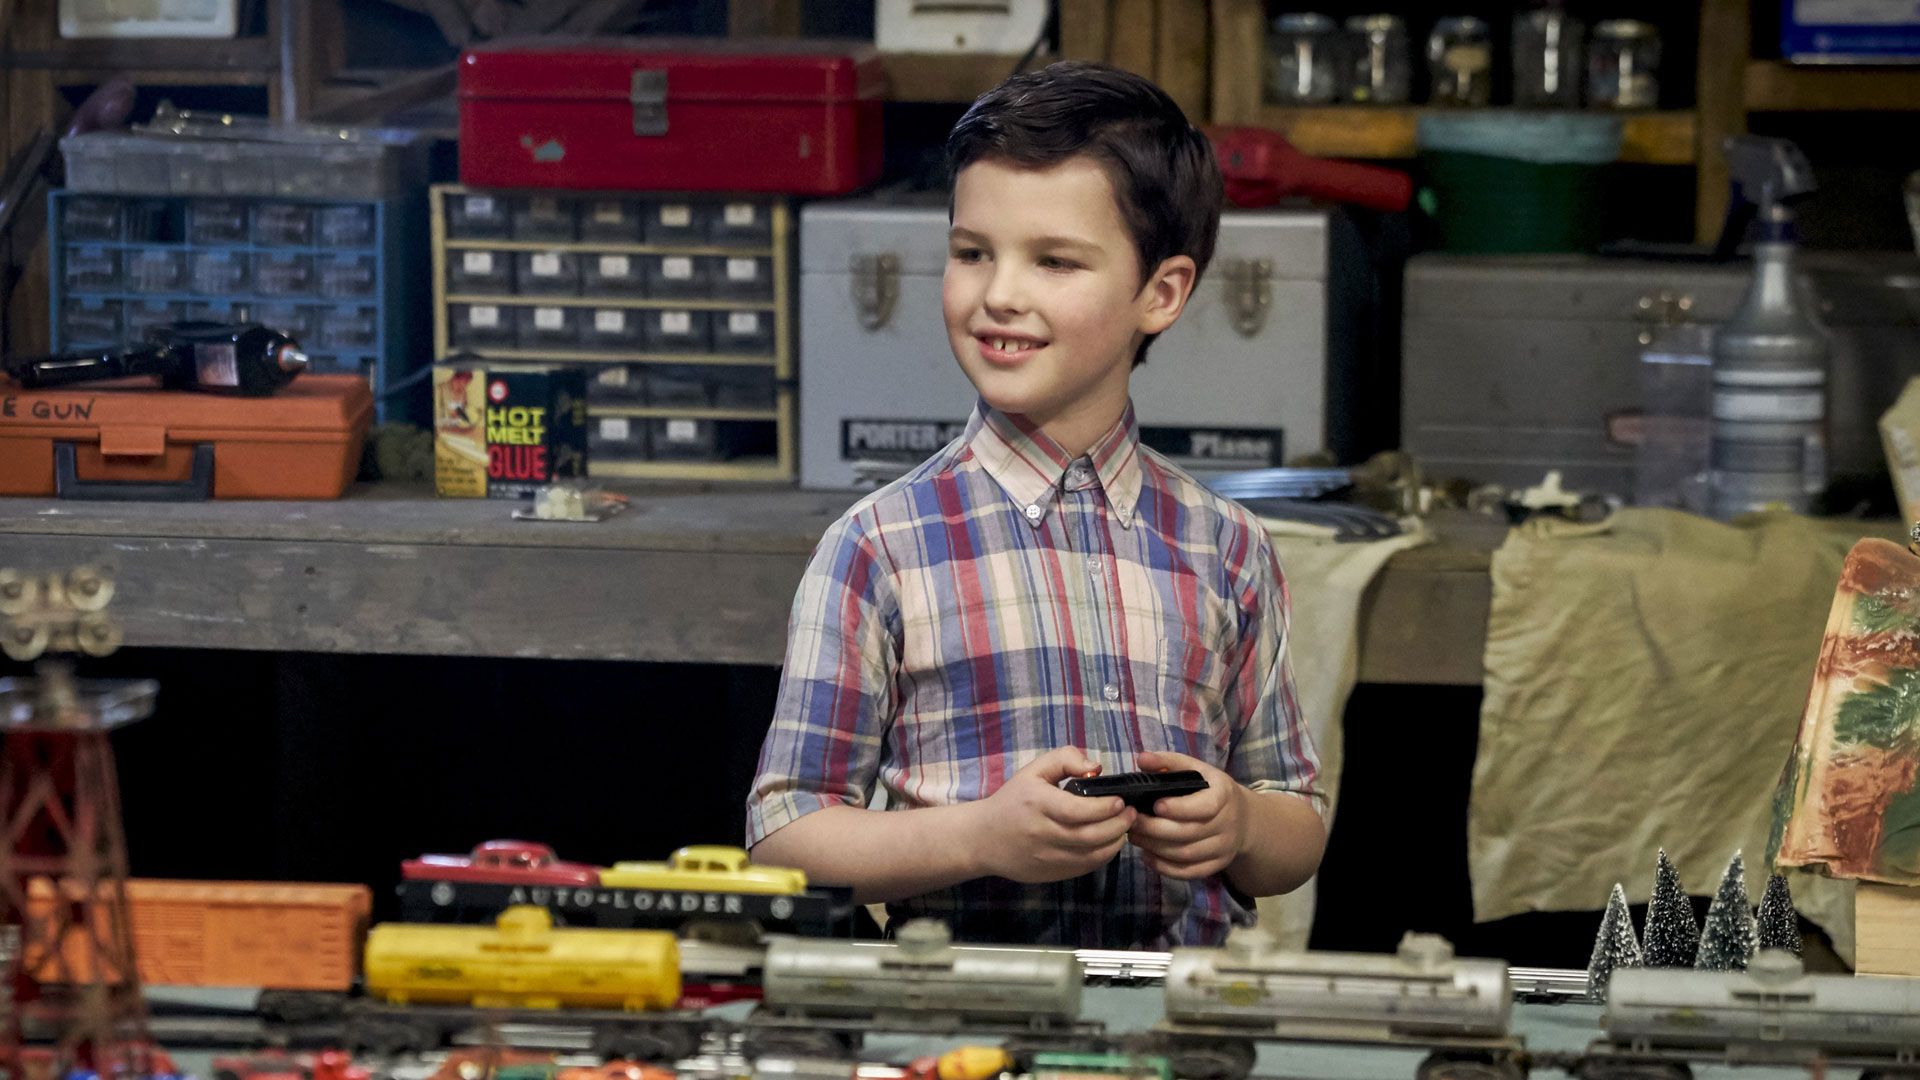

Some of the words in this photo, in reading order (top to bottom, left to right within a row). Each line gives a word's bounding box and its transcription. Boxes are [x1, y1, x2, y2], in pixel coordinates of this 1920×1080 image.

[31, 397, 96, 420] GUN
[487, 407, 545, 428] HOT
[487, 427, 545, 445] MELT
[1189, 431, 1271, 458] Plano
[488, 445, 546, 480] GLUE
[509, 885, 743, 914] AUTO-LOADER
